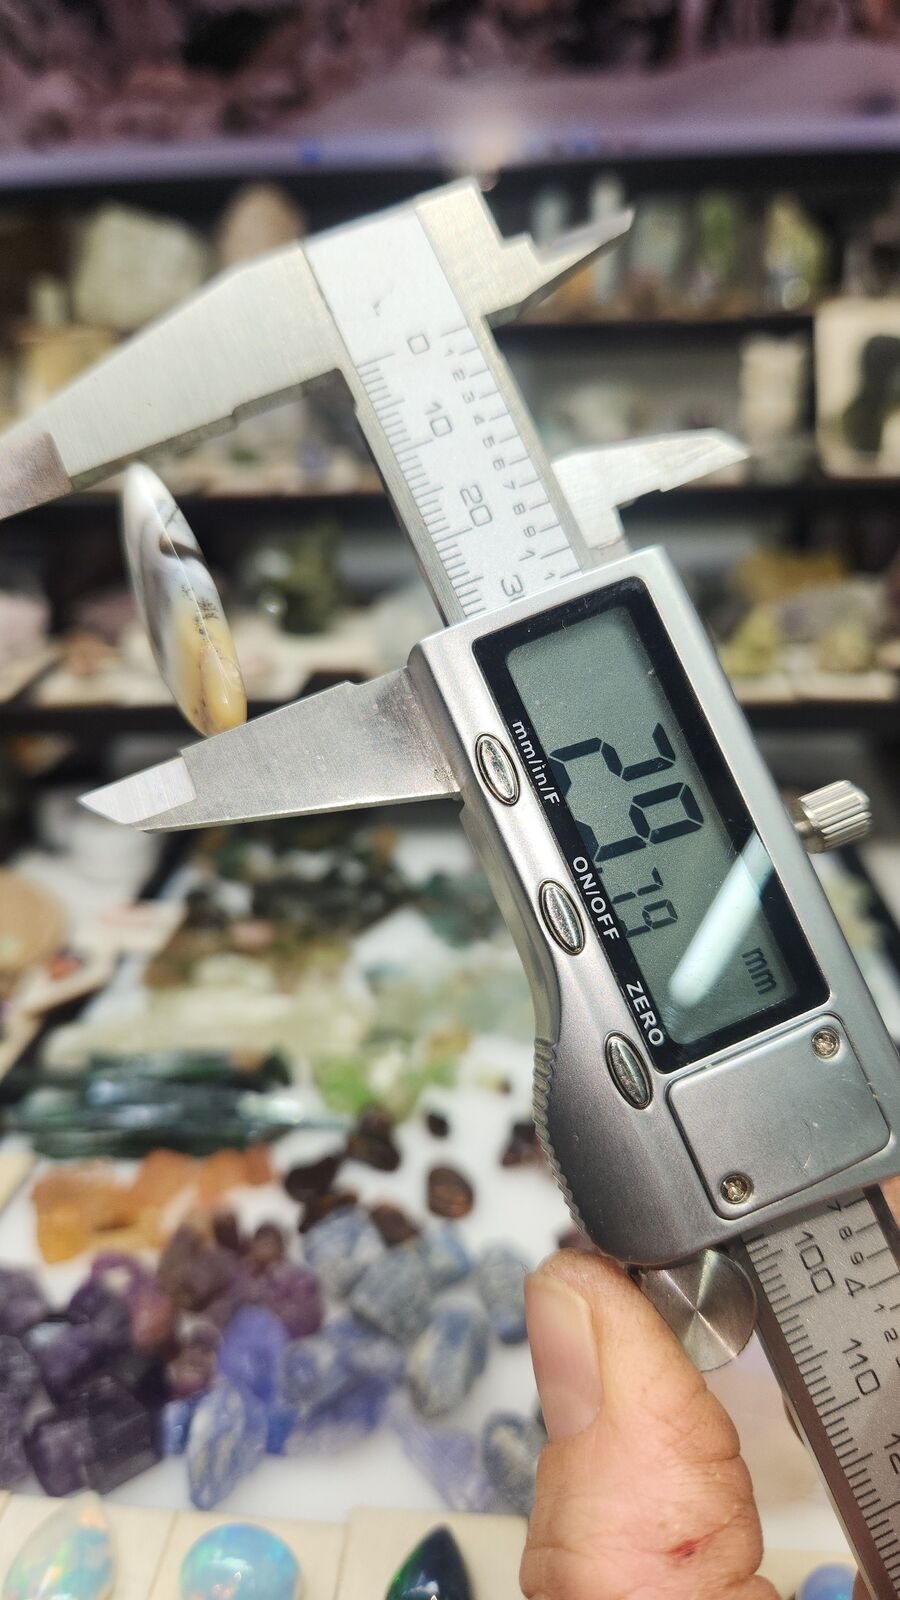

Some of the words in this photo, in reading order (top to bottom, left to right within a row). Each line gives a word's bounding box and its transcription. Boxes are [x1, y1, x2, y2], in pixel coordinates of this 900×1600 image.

[452, 368, 466, 382] 2
[462, 391, 476, 404] 3
[472, 415, 486, 425] 4
[482, 436, 496, 449] 5
[407, 334, 430, 355] 0
[425, 401, 453, 437] 10
[459, 484, 493, 527] 20
[501, 575, 527, 602] 3
[492, 459, 506, 471] 6
[502, 480, 516, 490] 7
[513, 503, 526, 516] 8
[523, 526, 536, 538] 9
[519, 549, 536, 562] 1
[512, 719, 560, 807] mm/in/F
[549, 722, 704, 938] 29.79
[741, 947, 777, 995] mm
[572, 856, 620, 941] ON/OFF
[626, 981, 665, 1046] ZERO
[839, 1226, 853, 1240] 8
[850, 1251, 864, 1265] 9
[844, 1278, 866, 1298] 4
[795, 1230, 836, 1294] 100
[842, 1338, 881, 1396] 110
[873, 1303, 886, 1313] 1
[883, 1327, 898, 1342] 2
